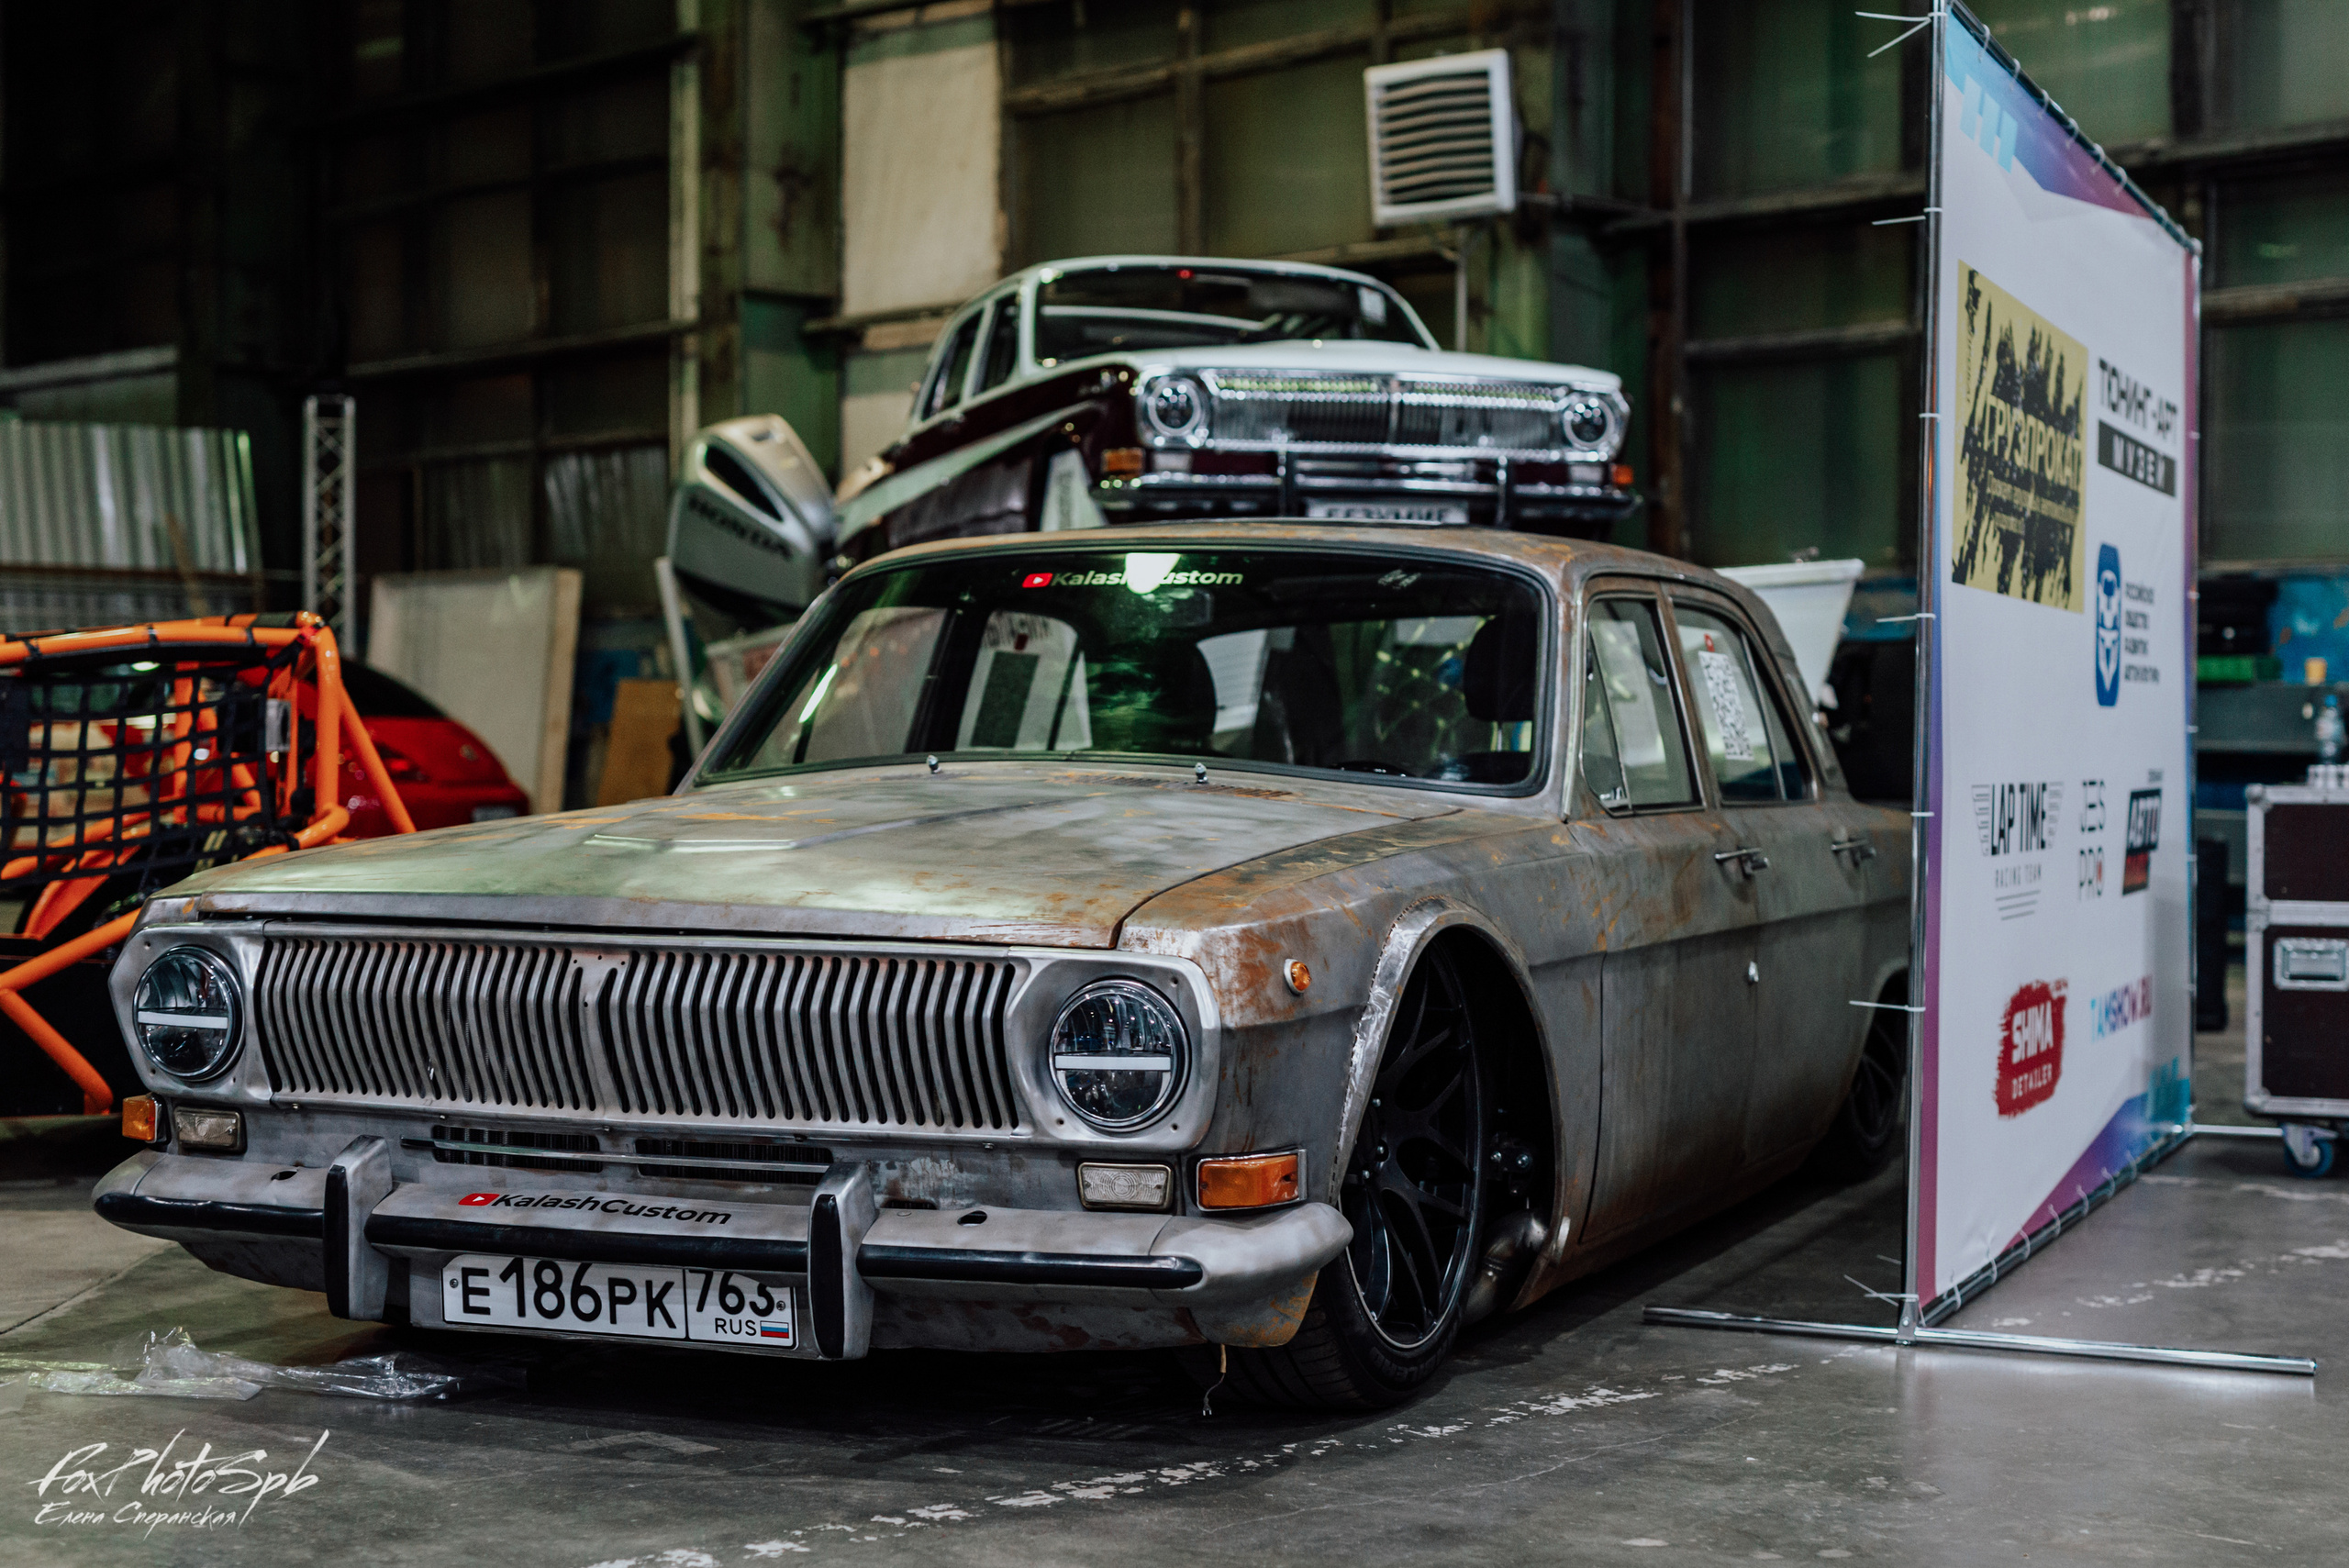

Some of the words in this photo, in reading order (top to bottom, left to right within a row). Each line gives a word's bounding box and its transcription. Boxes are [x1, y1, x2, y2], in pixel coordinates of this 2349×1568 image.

[1983, 392, 2083, 492] ГРУЗПРОКАТ
[1051, 570, 1243, 586] Kalasustom
[1991, 784, 2015, 855] LAP
[2020, 783, 2047, 851] TIME
[2011, 1000, 2054, 1064] SHIMA
[2012, 1062, 2053, 1099] DETAILER
[491, 1194, 732, 1225] KalashCustom
[688, 1270, 774, 1317] 763
[715, 1318, 756, 1336] RUS
